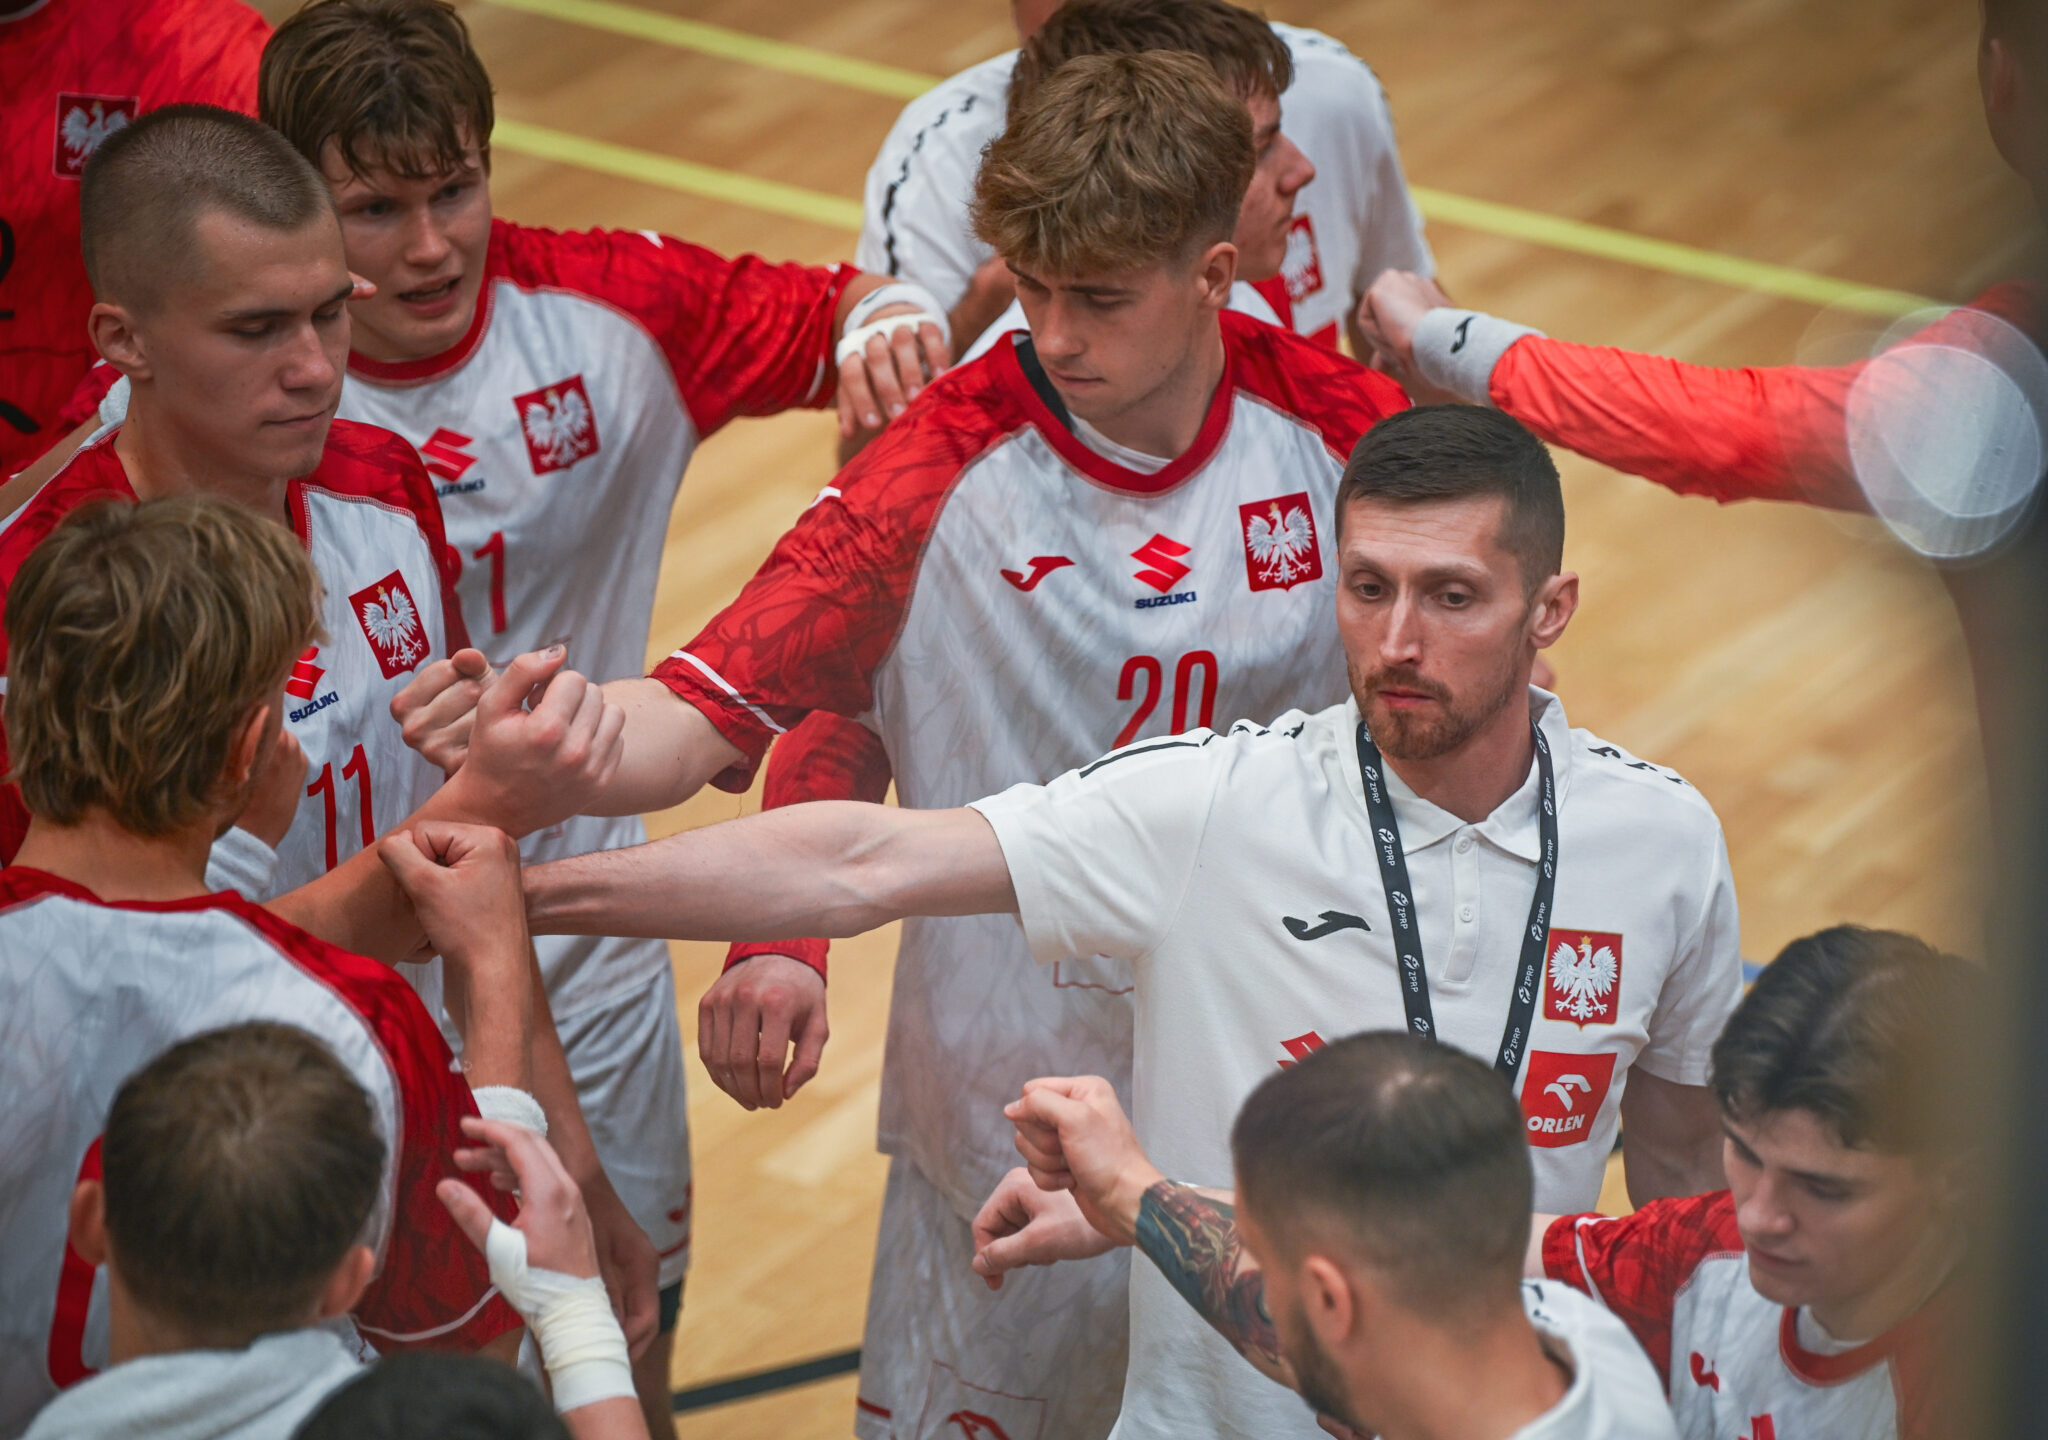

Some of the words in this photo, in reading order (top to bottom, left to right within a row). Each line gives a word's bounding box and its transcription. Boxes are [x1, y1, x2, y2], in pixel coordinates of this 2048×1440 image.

[436, 478, 485, 497] UZUKI
[1135, 591, 1197, 609] SUZUKI
[289, 690, 339, 723] SUZUKI
[1111, 650, 1218, 751] 20
[1369, 782, 1381, 804] ZPRP
[307, 744, 375, 873] 11
[1383, 844, 1396, 867] ZPRP
[1397, 907, 1409, 930] ZPRP
[1536, 902, 1547, 924] ZPRP
[1408, 971, 1419, 993] ZPRP
[1523, 964, 1535, 988] ZPRP
[1510, 1026, 1521, 1049] ZPRP
[1527, 1114, 1585, 1133] ORLEN
